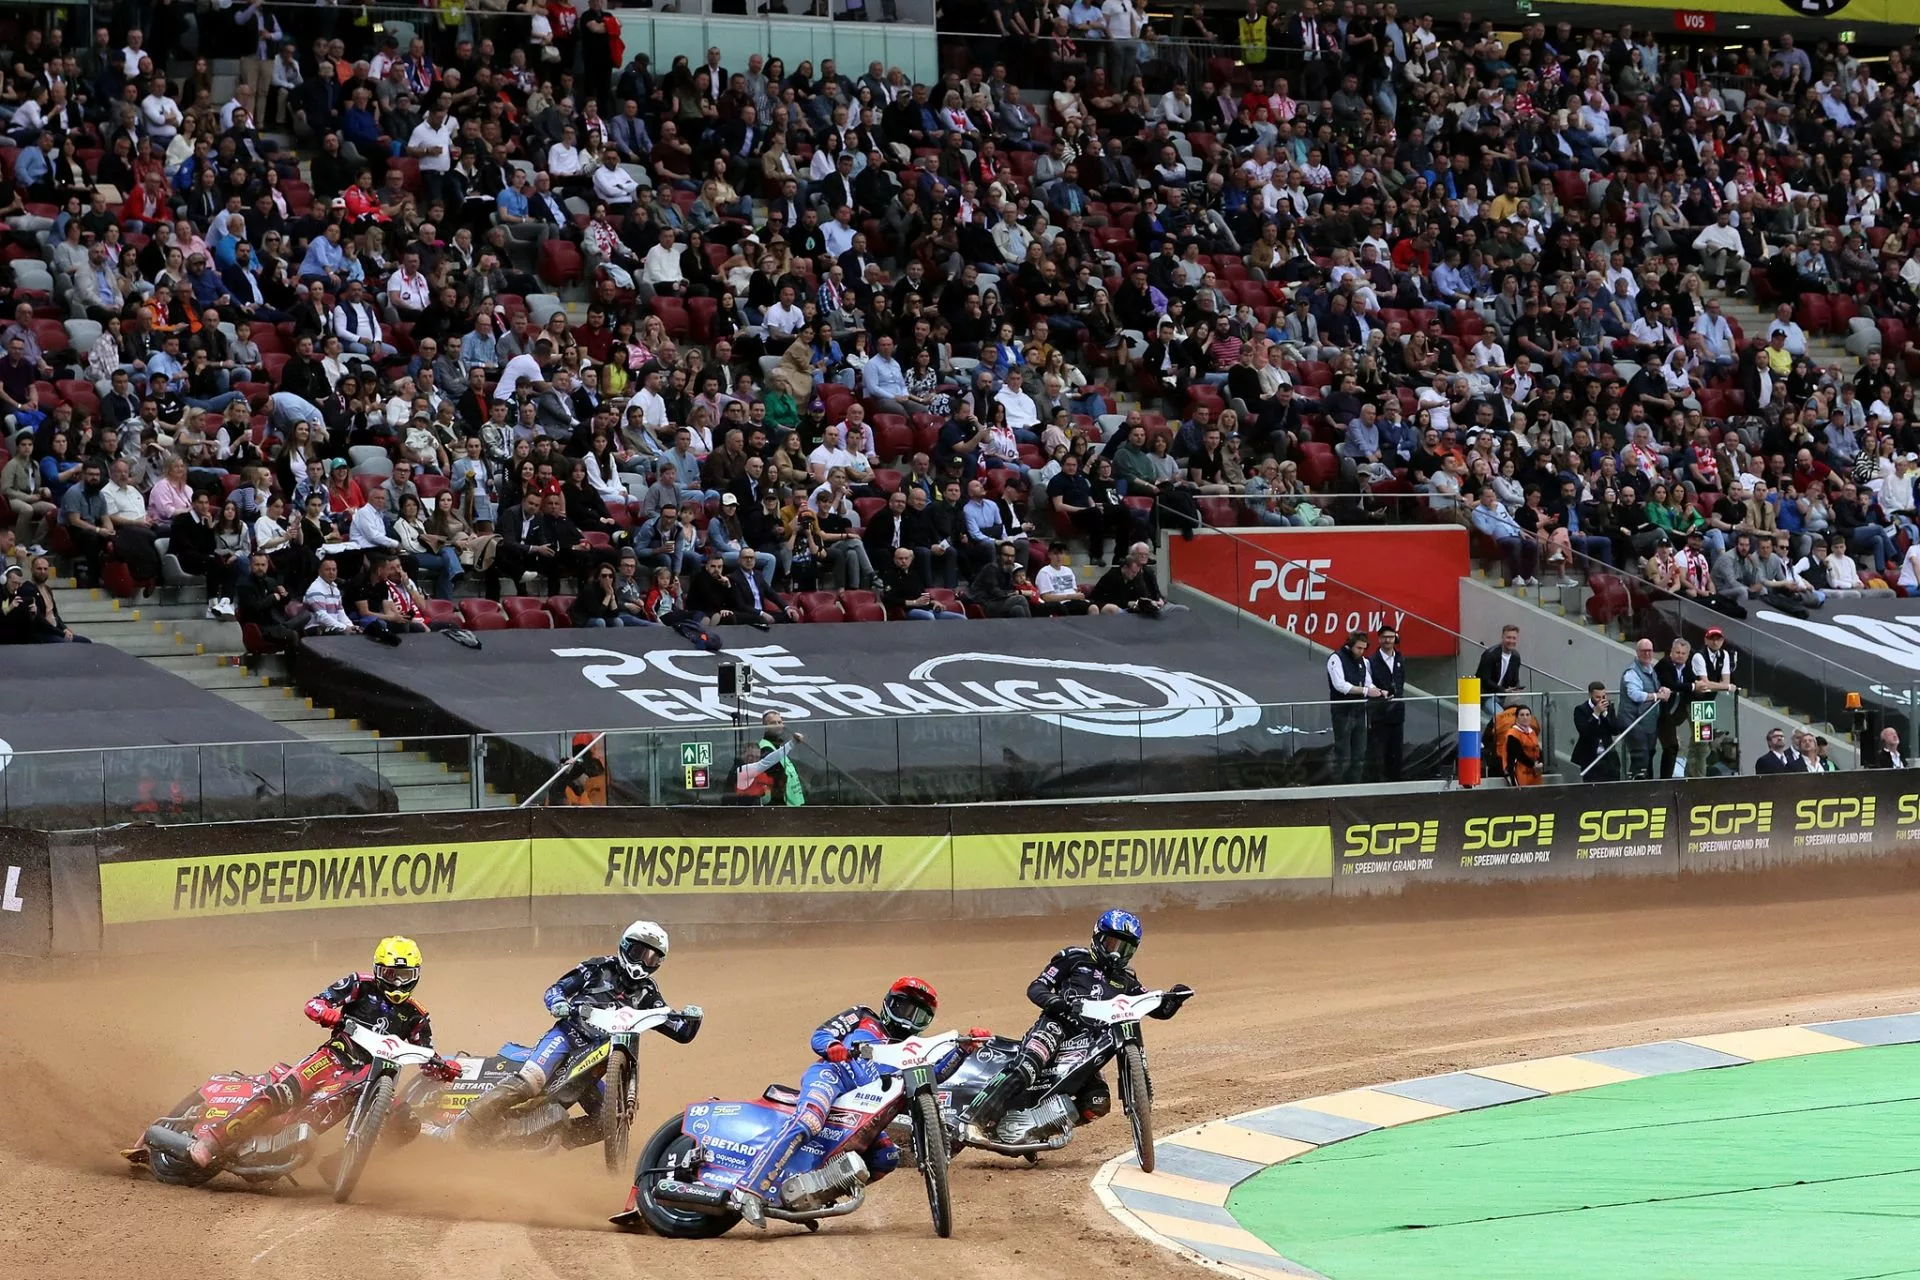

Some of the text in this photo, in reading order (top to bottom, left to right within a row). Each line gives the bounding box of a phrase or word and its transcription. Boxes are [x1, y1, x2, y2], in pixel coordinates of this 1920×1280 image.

[1249, 559, 1331, 602] PGE
[1257, 610, 1405, 634] ARODOWY
[616, 679, 1148, 721] EKSTRALIGA
[1578, 808, 1648, 843] SGP
[1689, 802, 1756, 837] SGP
[1795, 797, 1860, 830] SGP
[1344, 821, 1420, 857] SGP
[1462, 815, 1537, 850] SGP
[1688, 838, 1769, 853] FIM SPEEDWAY GRAND PRIX
[1793, 831, 1872, 847] FIM SPEEDWAY GRAND PRIX
[604, 844, 883, 887] FIMSPEEDWAY.COM
[1019, 835, 1268, 880] FIMSPEEDWAY.COM
[1341, 858, 1434, 875] FIM SPEEDWAY GRAND PRIX
[1460, 851, 1550, 867] FIM SPEEDWAY GRAND PRIX
[1576, 844, 1662, 859] FIM SPEEDWAY GRAND PRIX
[0, 866, 23, 911] L
[174, 852, 458, 909] FIMSPEEDWAY.COM
[902, 1057, 927, 1066] ORLEN
[711, 1137, 757, 1156] BETARD
[716, 1153, 746, 1167] aquapark
